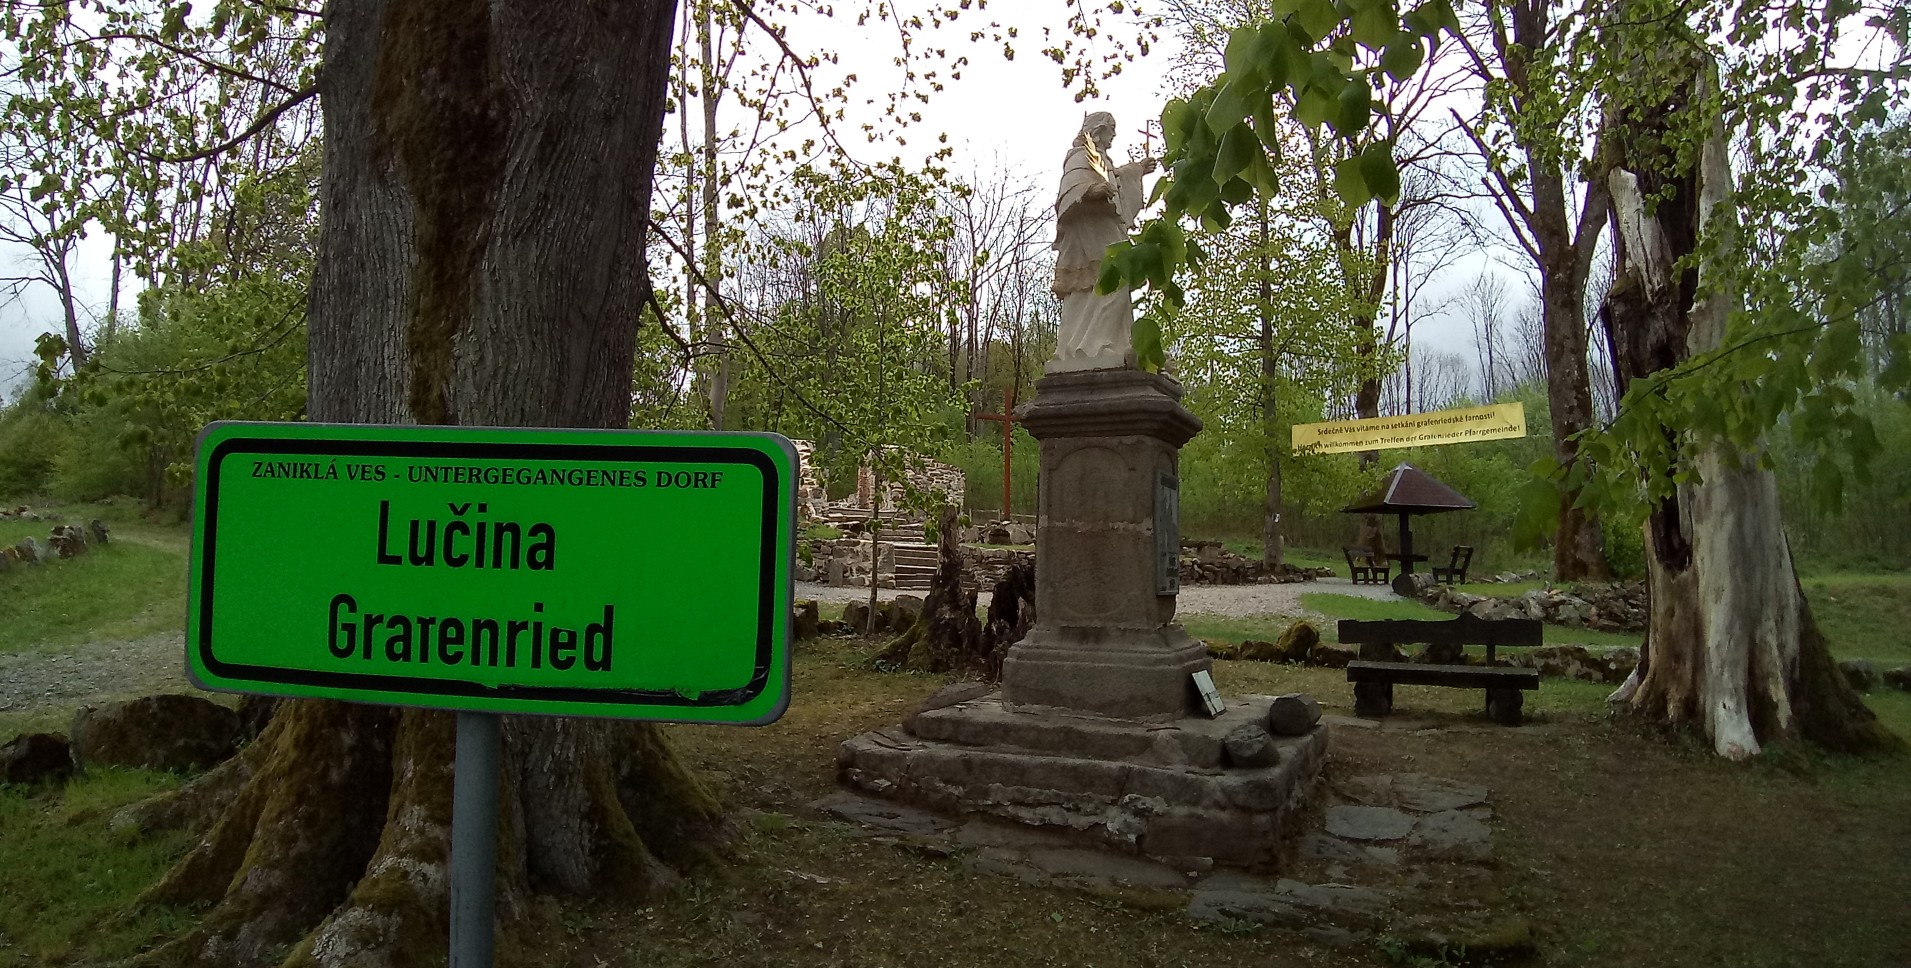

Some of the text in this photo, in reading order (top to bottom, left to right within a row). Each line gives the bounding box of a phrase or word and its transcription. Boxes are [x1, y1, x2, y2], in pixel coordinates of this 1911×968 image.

[1317, 426, 1343, 436] Srdečně
[1416, 416, 1464, 428] grafenriedské
[1465, 411, 1495, 422] farnosti!
[1324, 440, 1364, 449] willkommen
[1380, 436, 1405, 444] Treffen
[1464, 425, 1521, 438] Pfarrgemeinde!
[252, 458, 339, 480] ZANIKLÁ
[346, 464, 387, 482] VES
[408, 465, 647, 488] UNTERGEGANGENES
[655, 470, 724, 489] DORF
[376, 499, 557, 571] Lučina
